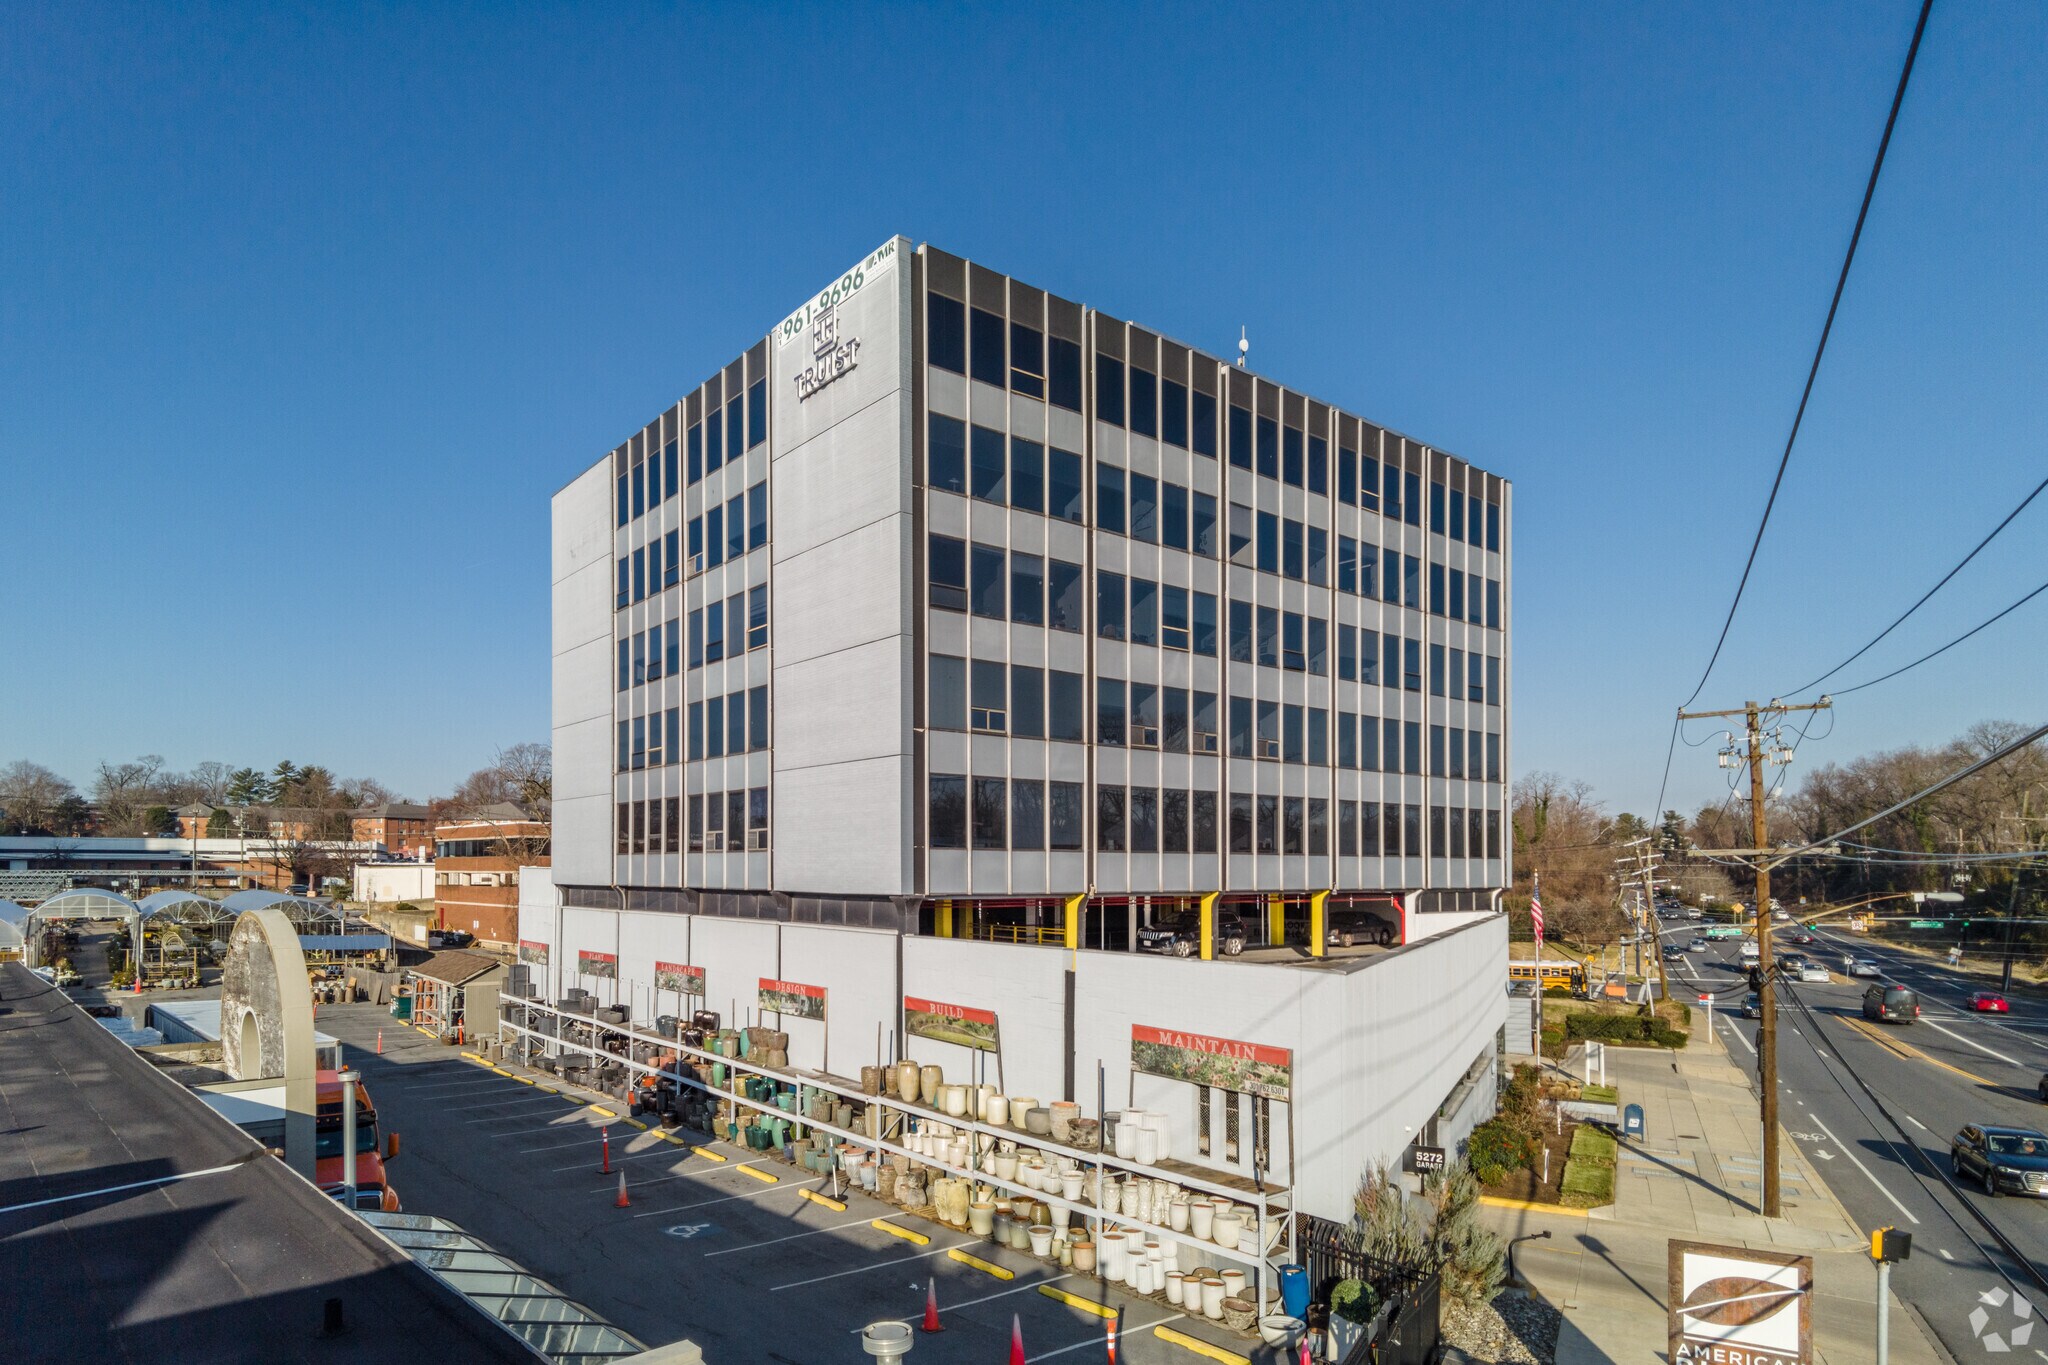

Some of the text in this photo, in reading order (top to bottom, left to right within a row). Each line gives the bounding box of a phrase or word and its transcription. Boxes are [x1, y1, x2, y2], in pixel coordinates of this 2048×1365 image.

[794, 337, 861, 401] TRUIST
[589, 952, 604, 962] PLANT
[661, 963, 696, 977] LANDSCAPE
[775, 981, 806, 996] DESIGN
[929, 1003, 964, 1019] BUILD
[1158, 1031, 1257, 1061] MAINTAIN
[1270, 1085, 1285, 1097] 6301
[1416, 1151, 1443, 1163] 5272
[1676, 1343, 1806, 1365] AMERIC
